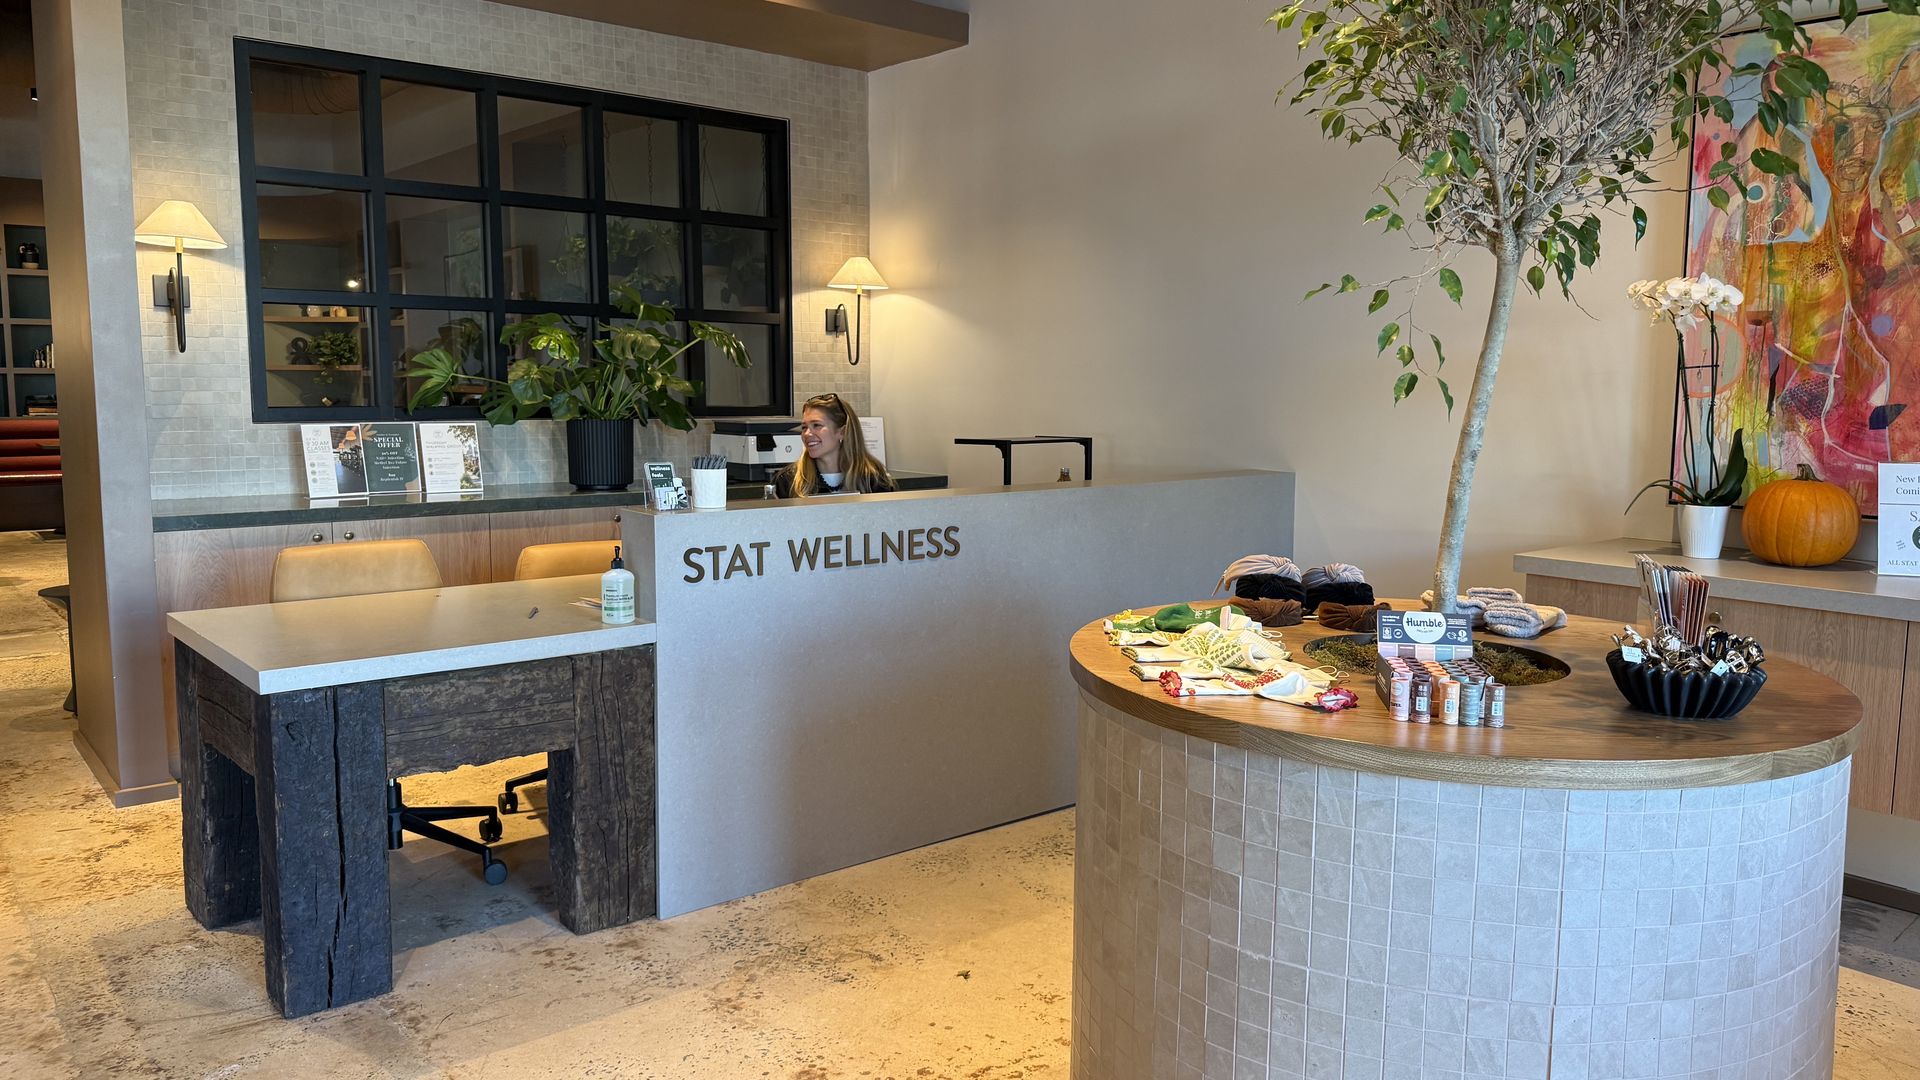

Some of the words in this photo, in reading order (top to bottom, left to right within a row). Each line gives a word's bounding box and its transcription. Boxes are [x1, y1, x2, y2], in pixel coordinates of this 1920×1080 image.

[1896, 475, 1915, 483] New
[683, 541, 771, 583] STAT
[787, 525, 961, 572] WELLNESS
[1406, 617, 1444, 628] Humble
